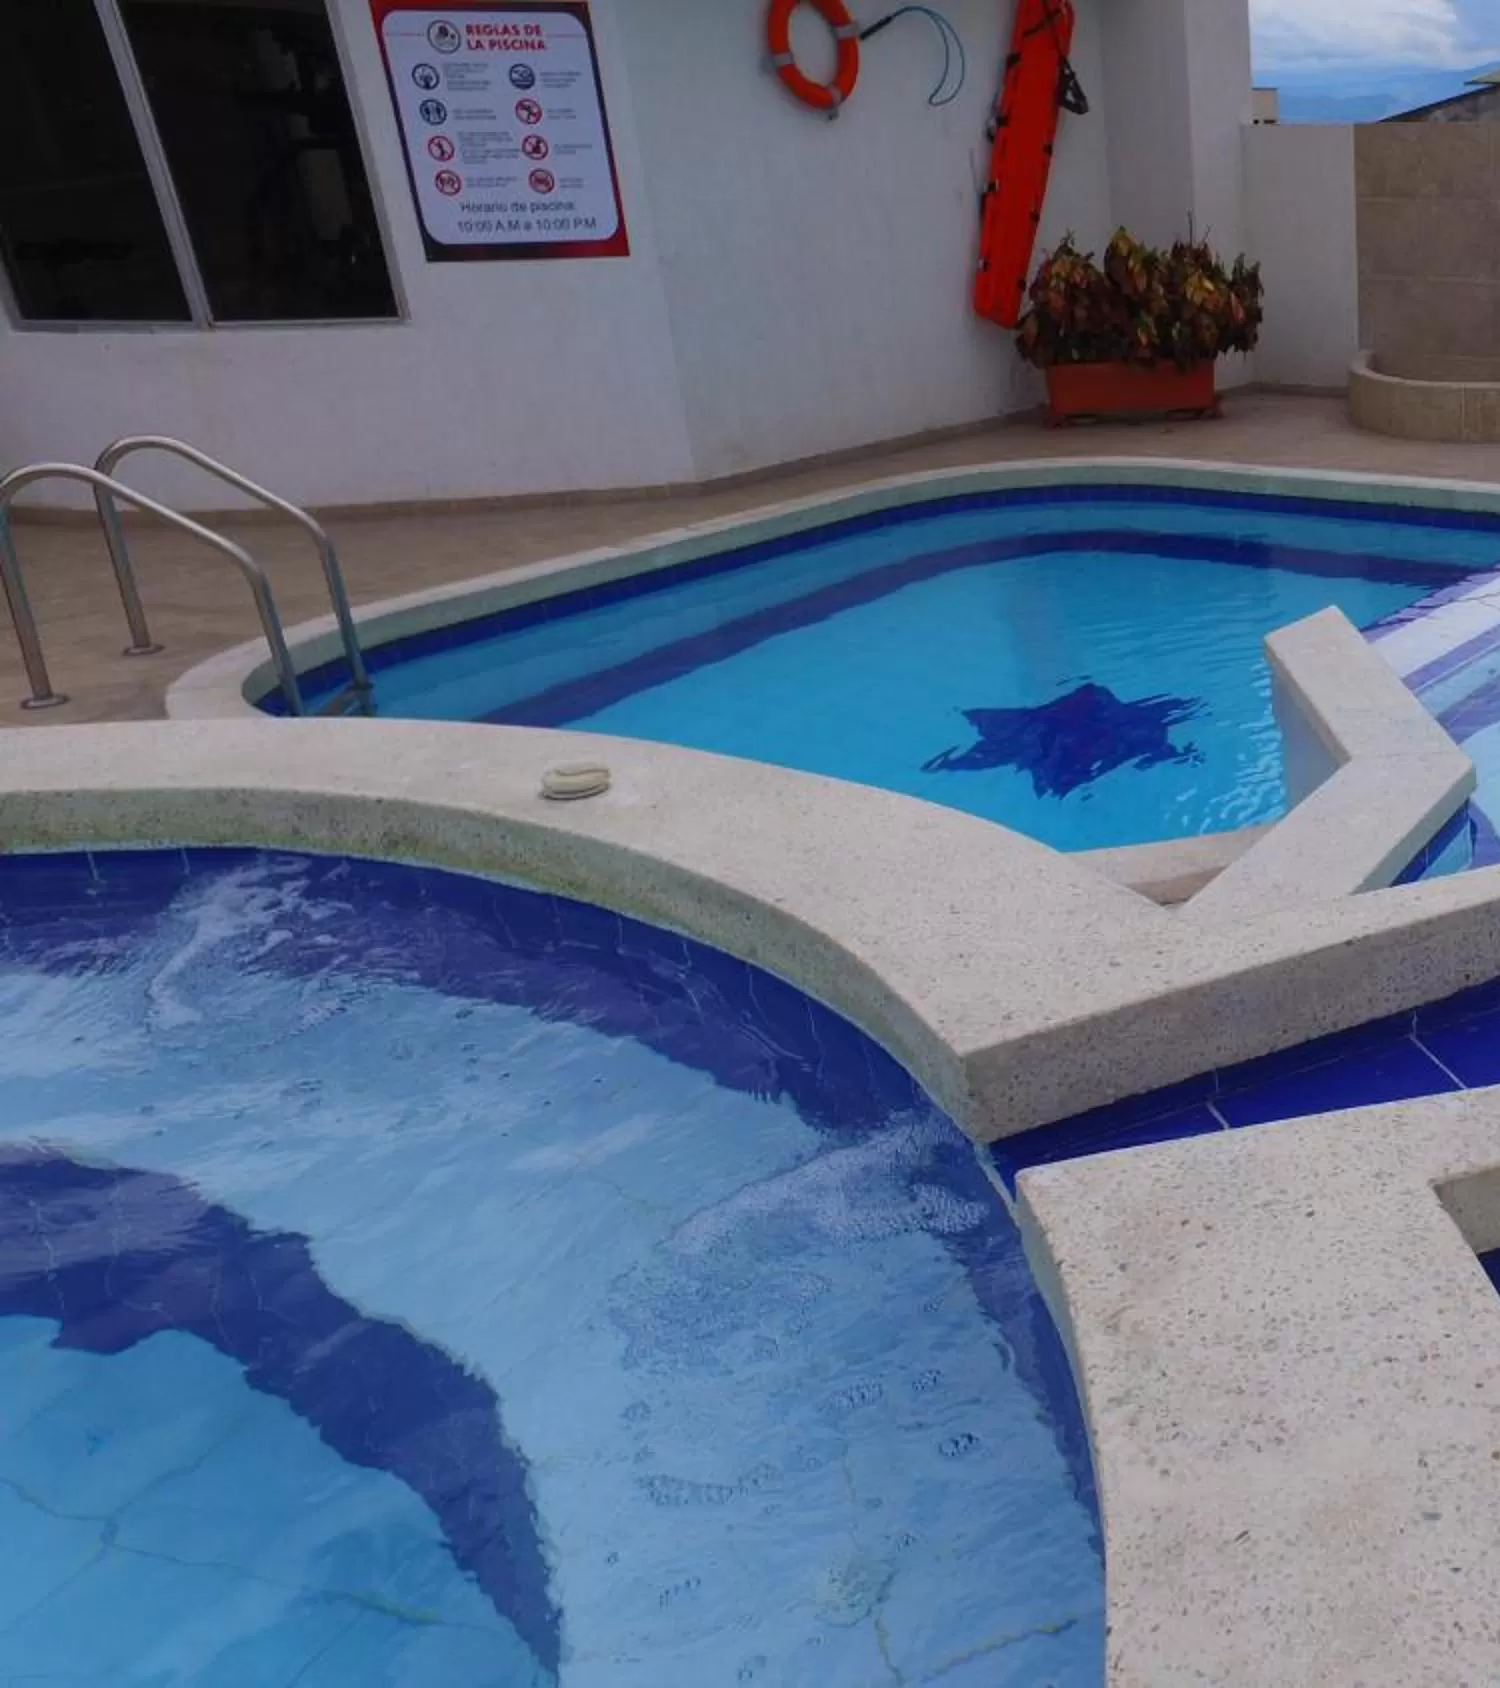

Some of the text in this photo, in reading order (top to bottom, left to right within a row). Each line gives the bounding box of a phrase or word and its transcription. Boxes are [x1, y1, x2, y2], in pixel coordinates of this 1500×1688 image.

[465, 23, 542, 37] REGLAS DE
[466, 38, 547, 50] LA PISCINA
[459, 201, 508, 213] Horario
[510, 201, 527, 212] de
